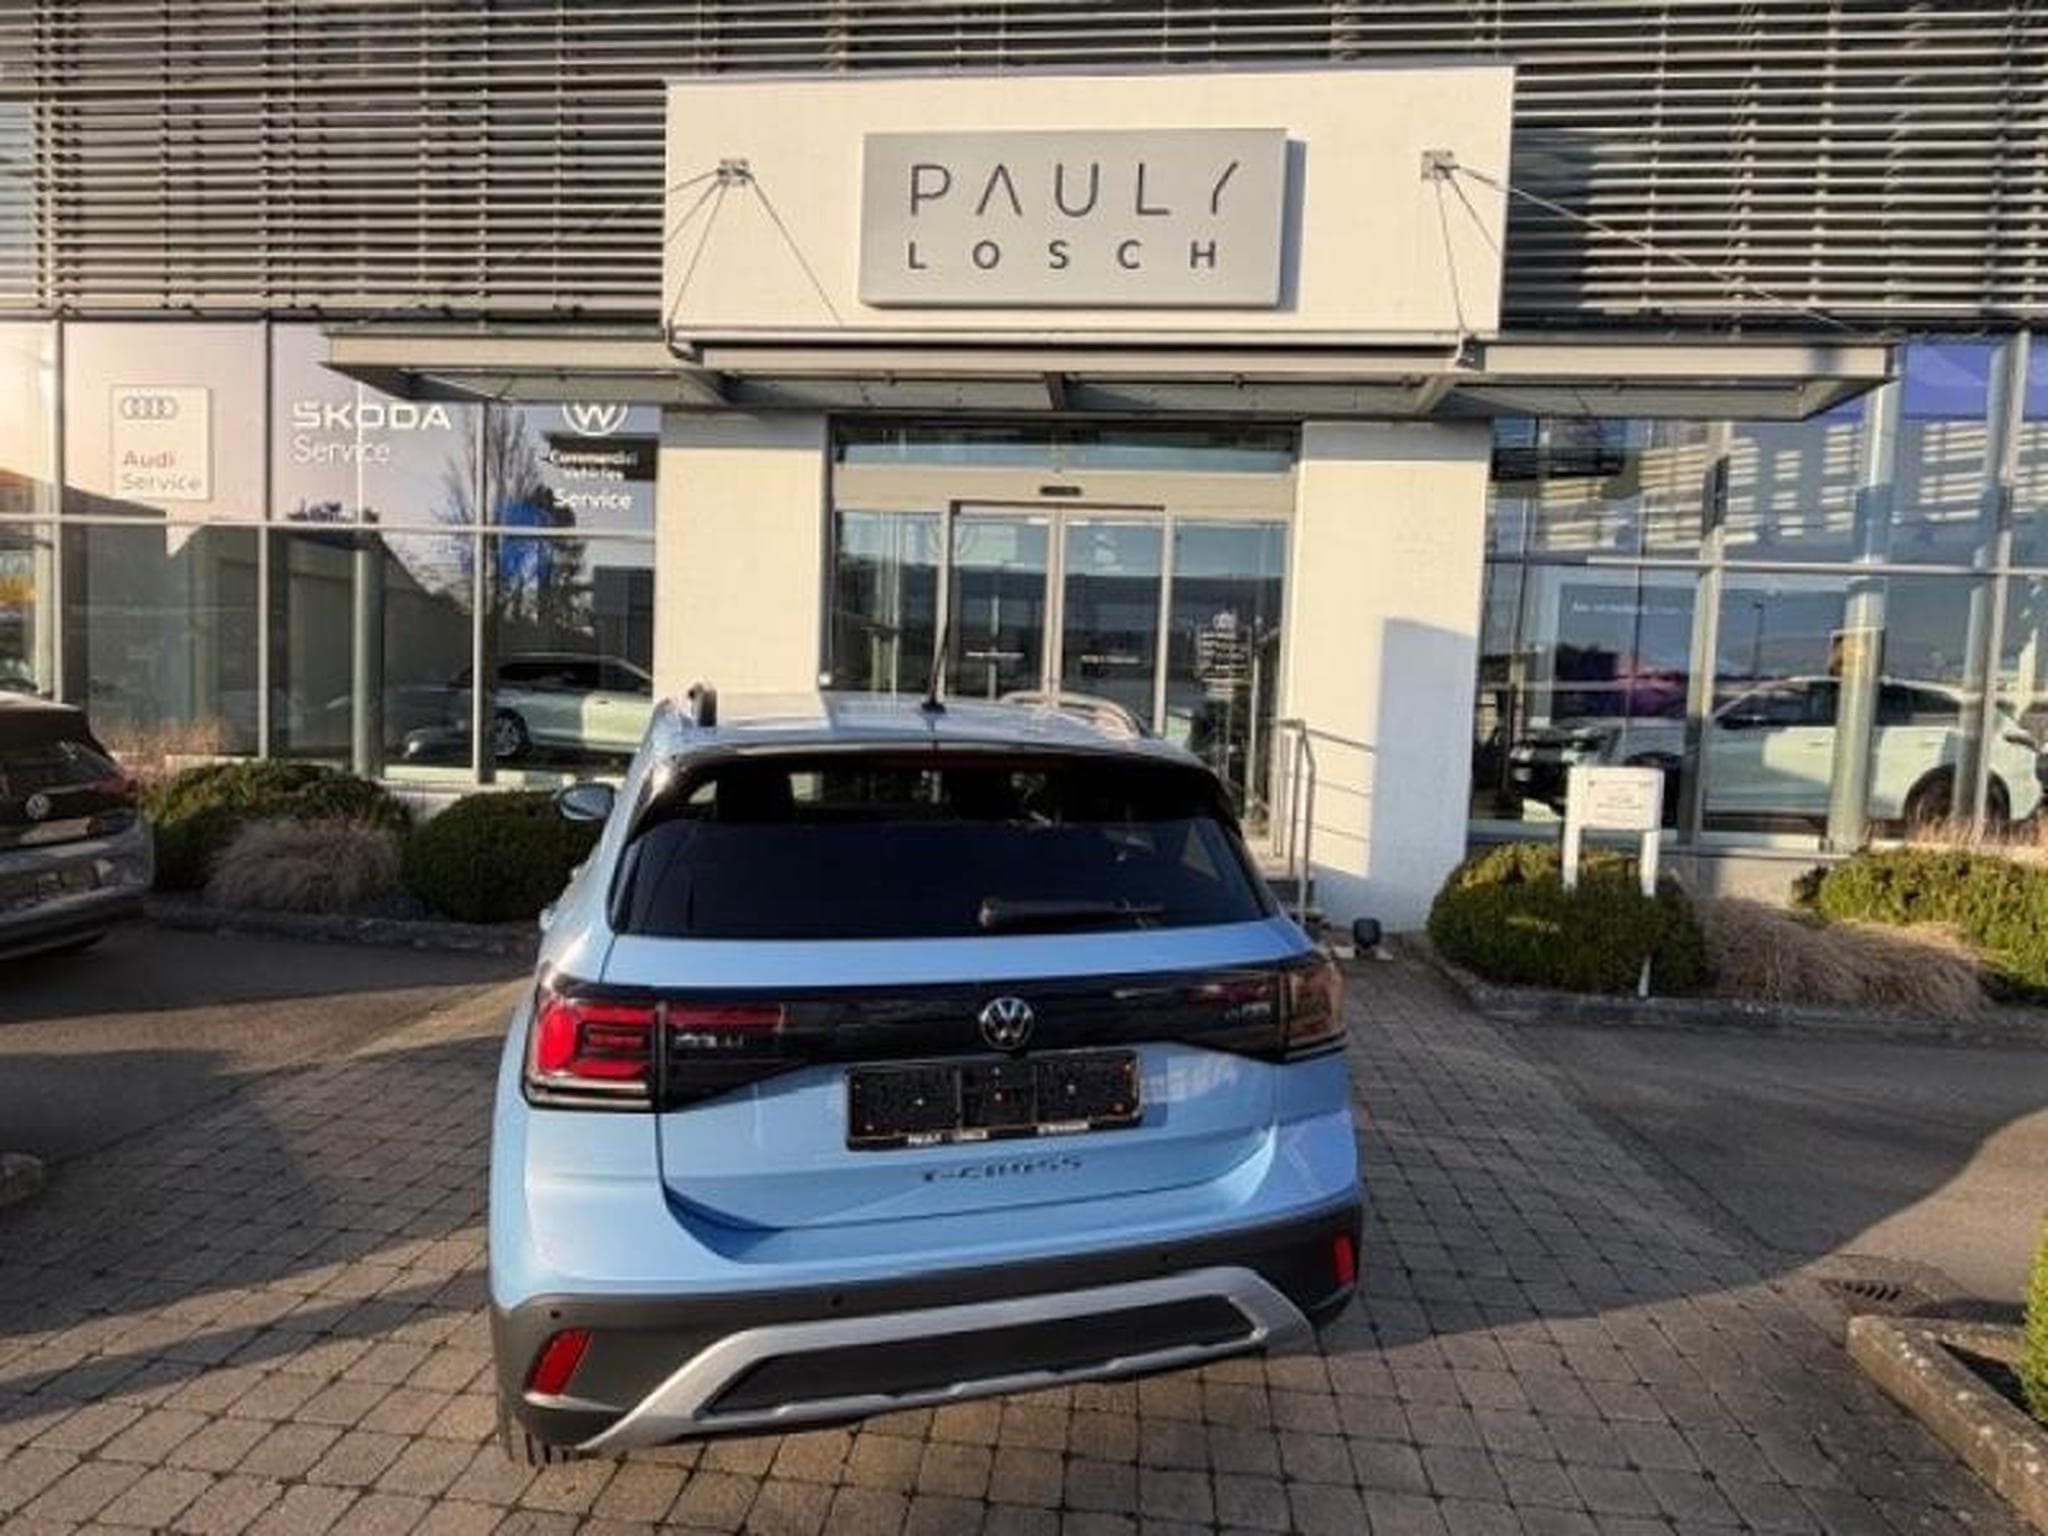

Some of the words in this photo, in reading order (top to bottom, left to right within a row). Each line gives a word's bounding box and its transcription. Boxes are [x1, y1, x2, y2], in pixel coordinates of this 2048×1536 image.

[910, 161, 1239, 217] PAULY
[908, 239, 1217, 269] LOSCH
[122, 448, 177, 468] Audi
[292, 433, 391, 463] Service
[121, 472, 203, 491] Service
[552, 487, 633, 509] Service
